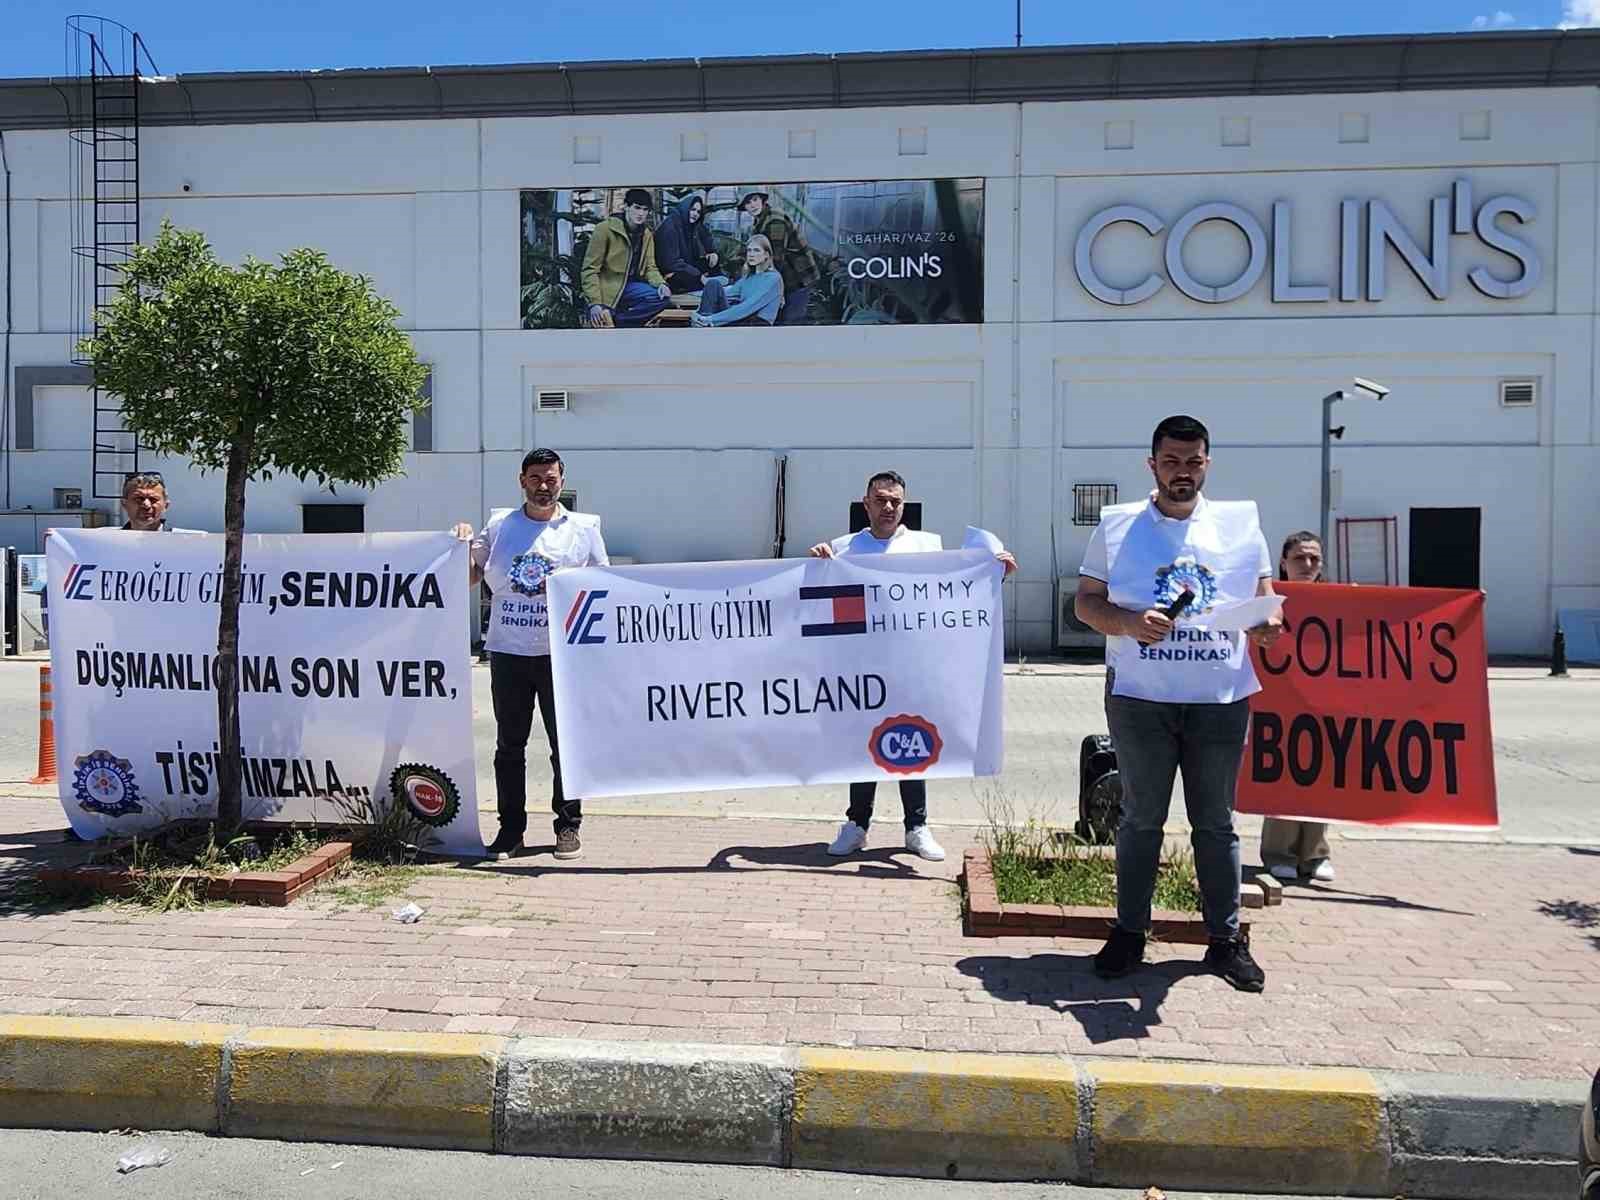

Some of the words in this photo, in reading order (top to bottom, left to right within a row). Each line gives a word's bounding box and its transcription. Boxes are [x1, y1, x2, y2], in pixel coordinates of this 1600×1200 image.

[1073, 178, 1541, 306] COLIN'S
[847, 252, 942, 279] COLIN'S
[100, 560, 192, 603] EROĞLU
[198, 563, 267, 604] GİİM
[868, 580, 974, 602] TOMMY
[502, 599, 514, 612] ÖZ
[517, 601, 548, 614] İPLİK
[616, 590, 703, 644] EROĞLU
[711, 587, 773, 640] GİYİM
[871, 609, 990, 633] HILFIGER
[1139, 645, 1231, 661] SENDİKASI
[1258, 614, 1459, 685] COLIN'S
[76, 643, 282, 697] DÜŞMANLINA
[291, 656, 360, 699] SON
[377, 660, 458, 701] VER,
[647, 680, 747, 722] RIVER
[762, 673, 887, 716] ISLAND
[881, 731, 931, 760] C&A
[1250, 711, 1466, 795] BOYKOT
